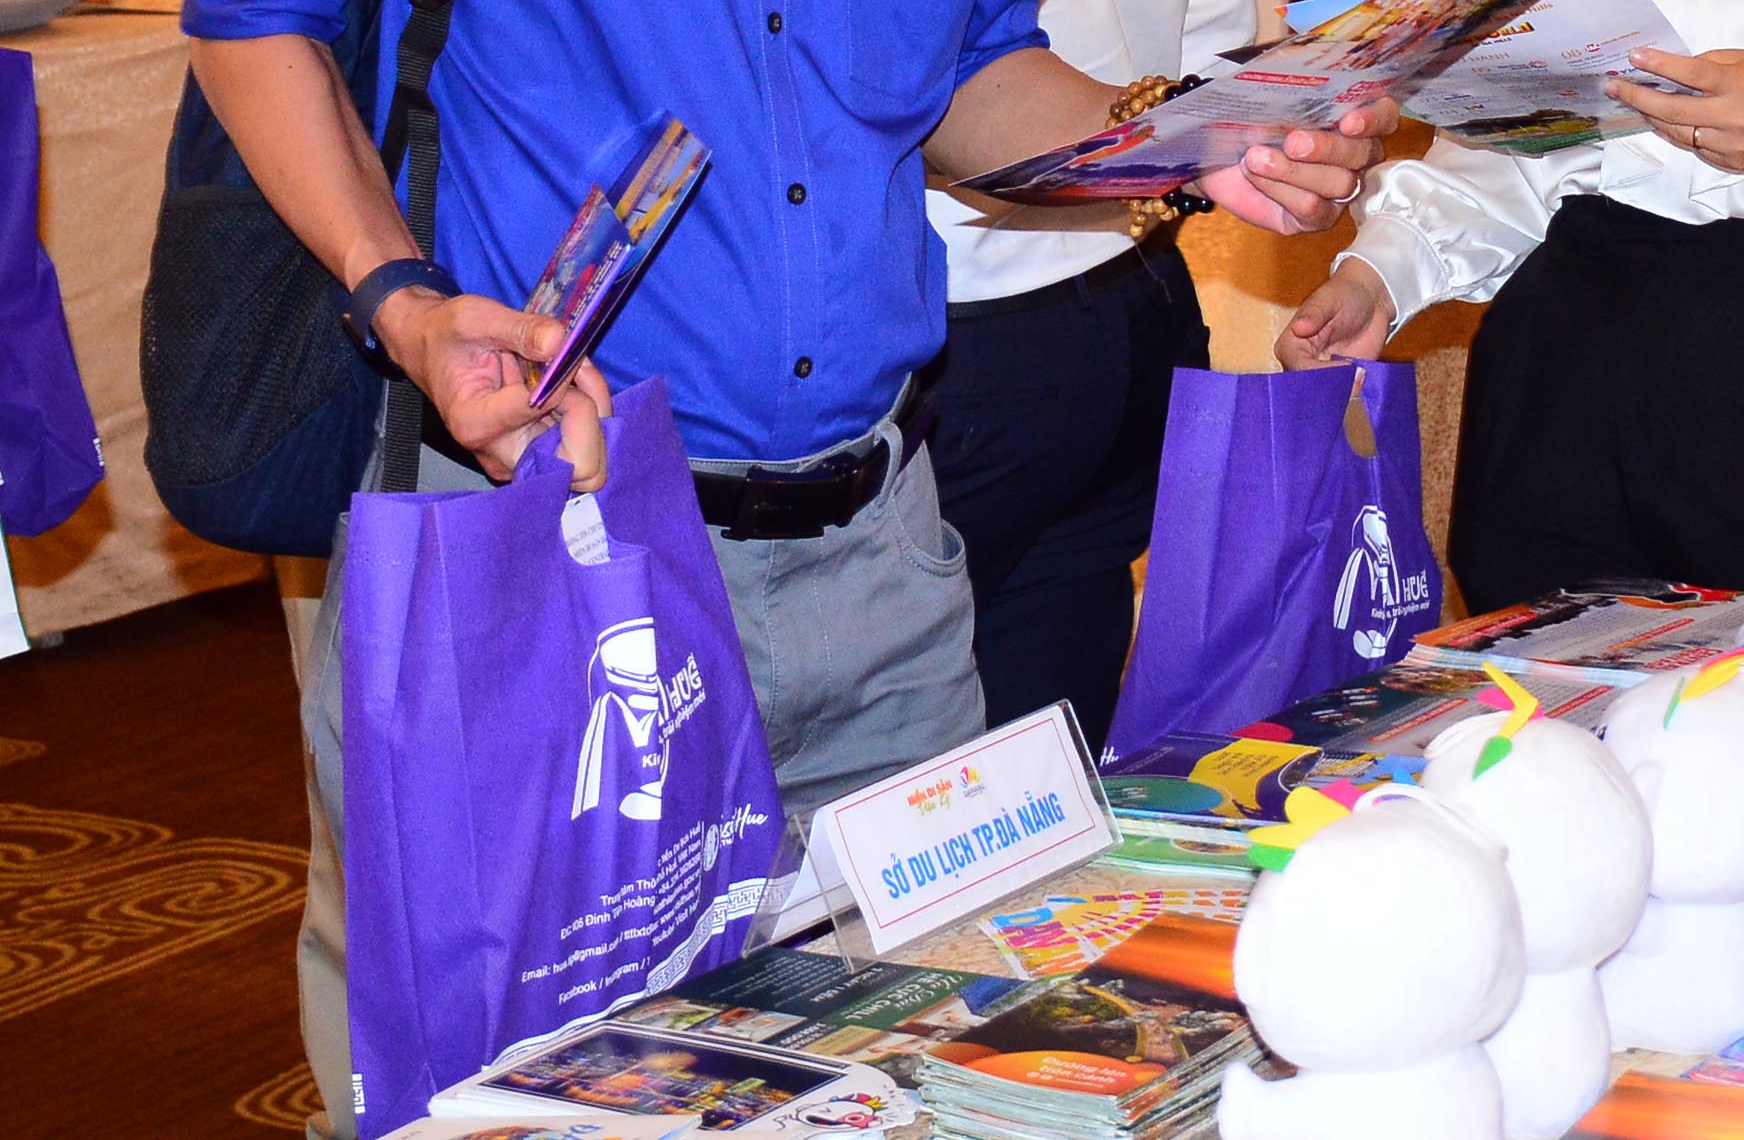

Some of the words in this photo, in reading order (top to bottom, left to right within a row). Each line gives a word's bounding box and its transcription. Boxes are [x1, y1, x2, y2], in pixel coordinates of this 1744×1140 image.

[880, 852, 912, 900] SỞ
[907, 849, 938, 889] DU
[934, 832, 978, 880] LỊCH
[971, 806, 1022, 858] TP.ĐÀ
[1015, 790, 1067, 838] NẴNG
[521, 964, 551, 983] Email:
